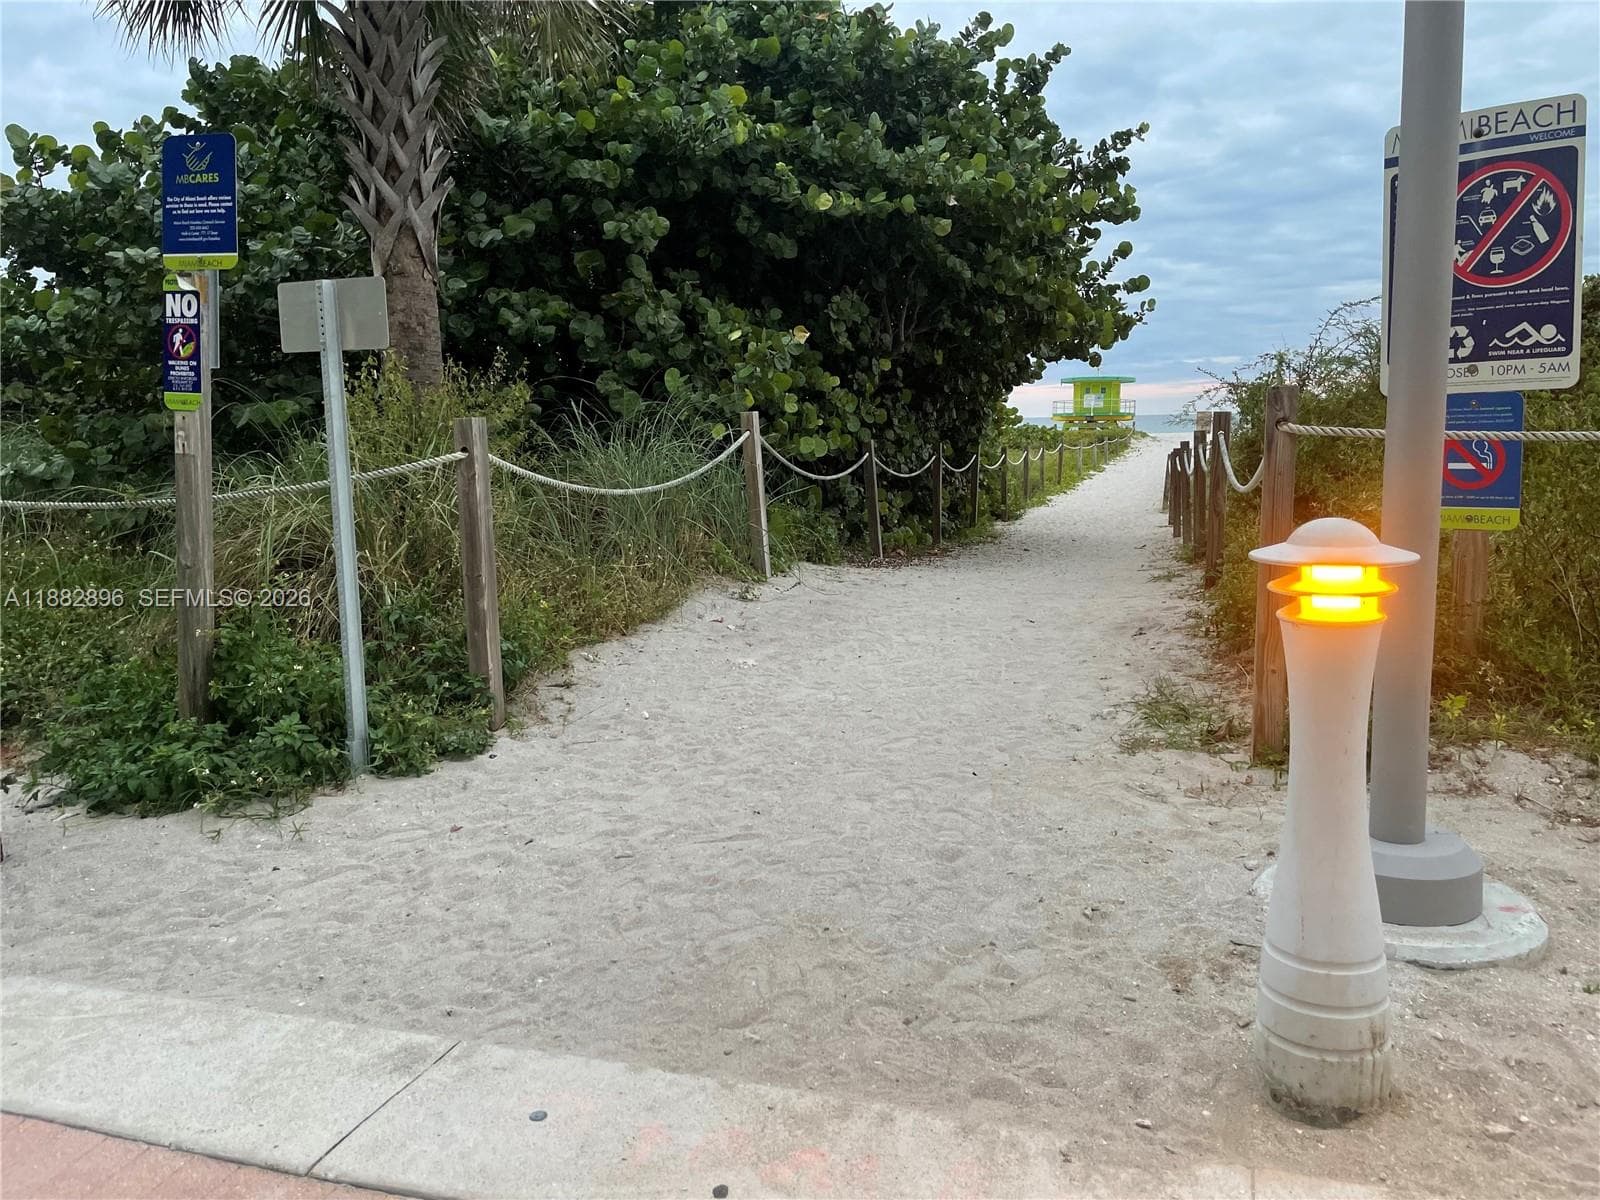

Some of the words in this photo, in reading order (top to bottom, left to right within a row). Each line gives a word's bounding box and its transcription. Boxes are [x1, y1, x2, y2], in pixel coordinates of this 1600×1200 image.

[1391, 100, 1577, 154] IBEACH
[1529, 128, 1576, 142] WELCOME
[176, 173, 219, 184] MBCARES
[166, 293, 198, 318] NO
[1448, 366, 1480, 378] OSED
[1490, 364, 1526, 376] 10PM
[1538, 362, 1570, 374] 5AM
[1440, 514, 1511, 524] IAMIBEACH
